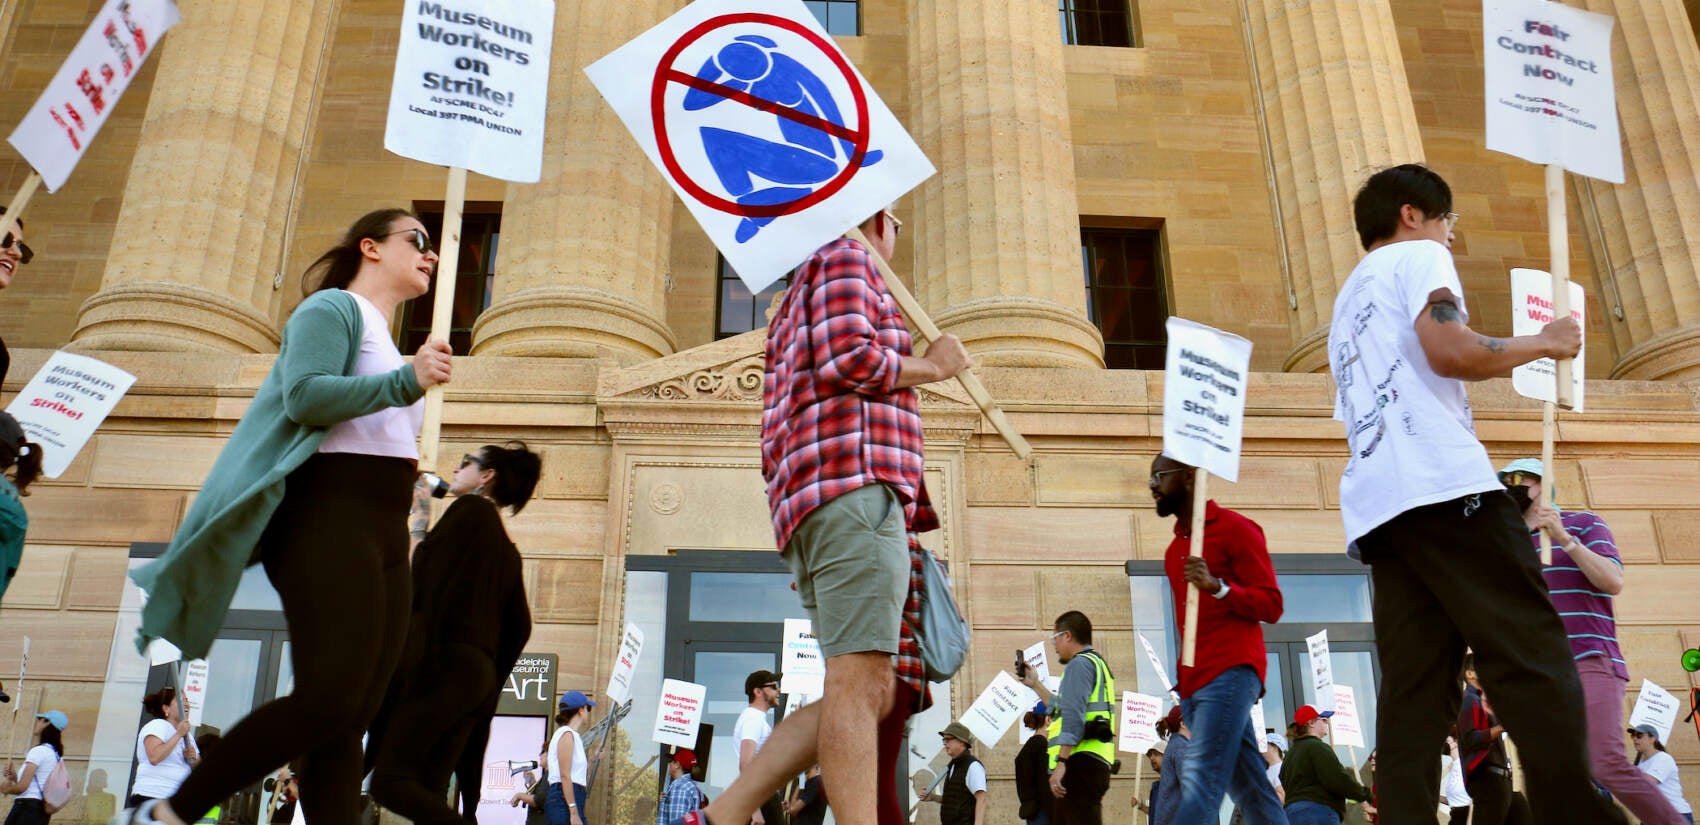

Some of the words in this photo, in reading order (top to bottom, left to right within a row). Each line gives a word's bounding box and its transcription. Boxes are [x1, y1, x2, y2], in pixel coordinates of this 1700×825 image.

[418, 1, 533, 44] Museum
[1524, 20, 1570, 41] Fair
[418, 23, 529, 65] Workers
[1497, 36, 1598, 74] Contract
[454, 56, 490, 76] on
[1523, 64, 1574, 87] Now
[422, 71, 514, 107] Strike!
[430, 96, 477, 110] AFSCME
[408, 104, 437, 118] Local
[439, 111, 458, 120] 397
[460, 113, 485, 126] PMA
[486, 121, 522, 136] UNION
[45, 375, 106, 401] Workers
[52, 365, 115, 390] Museum
[30, 398, 84, 420] Strike!
[55, 391, 74, 403] on
[516, 658, 549, 667] adelphia
[540, 665, 549, 673] of
[502, 672, 548, 701] Art
